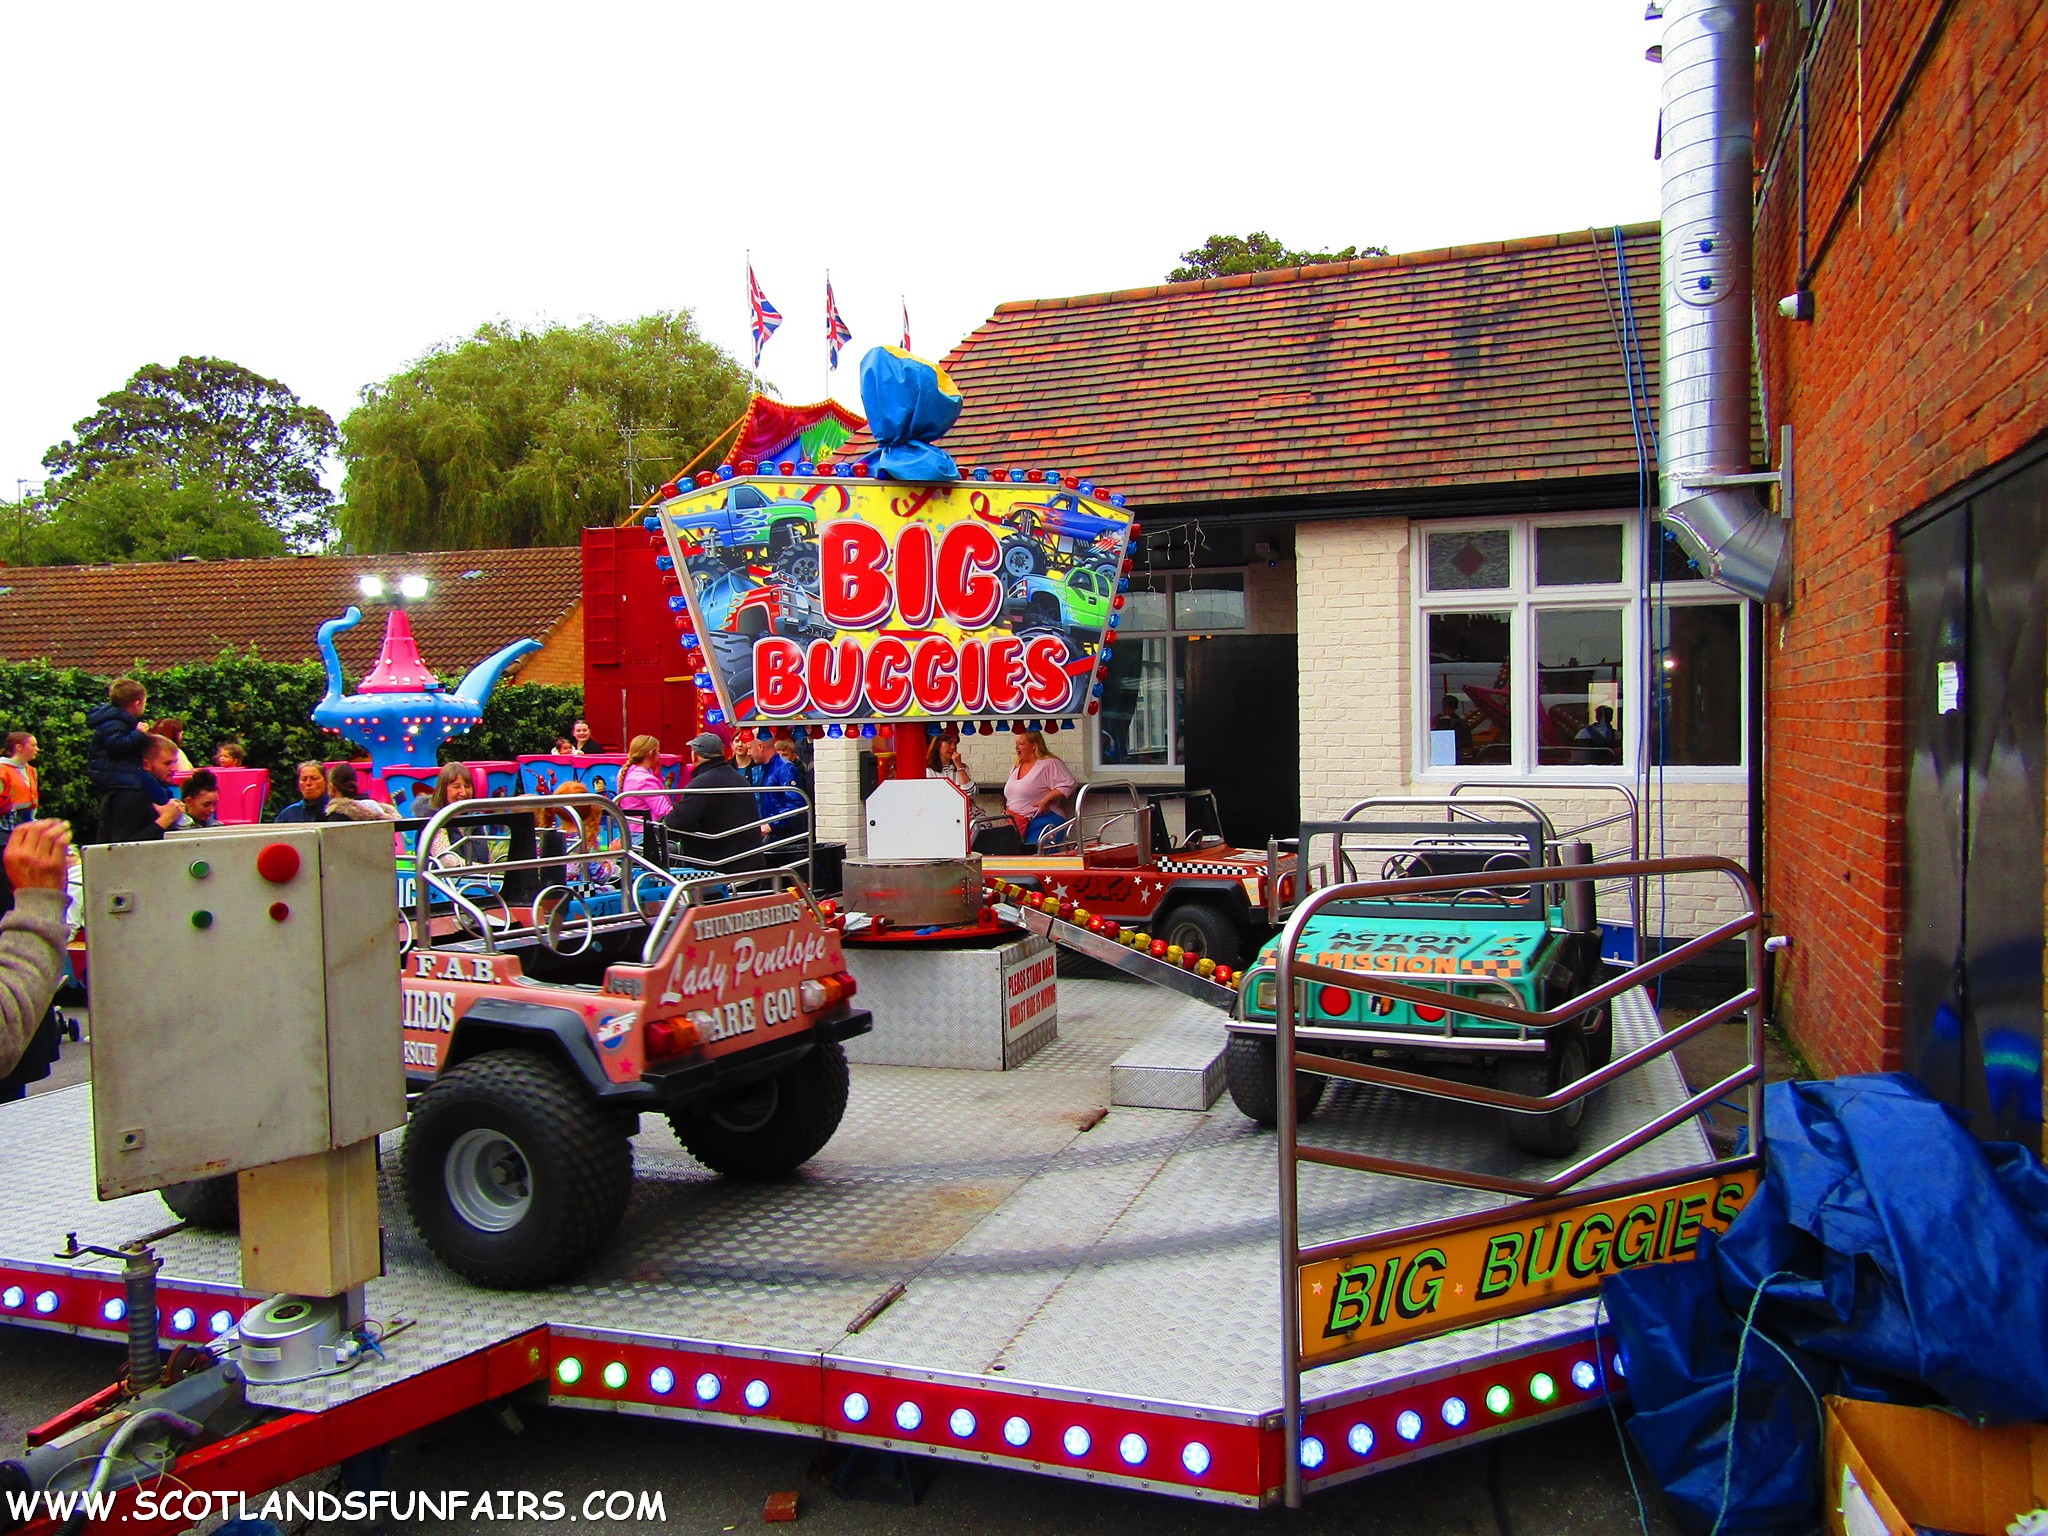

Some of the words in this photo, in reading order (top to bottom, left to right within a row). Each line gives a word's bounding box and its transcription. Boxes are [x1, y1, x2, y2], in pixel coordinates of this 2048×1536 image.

[818, 519, 1003, 630] BIG
[753, 634, 1073, 718] BUGGIES
[693, 902, 801, 941] THUNDERBIRDS
[1328, 932, 1472, 946] ACTION
[659, 950, 728, 1006] Lady
[733, 929, 826, 987] Penelope
[1316, 951, 1460, 976] MISSION
[1330, 941, 1458, 955] MAN
[415, 954, 502, 984] F.A.B.
[605, 970, 643, 1001] Jeep
[1008, 969, 1026, 999] PLEASE
[1026, 962, 1042, 989] STAND
[1042, 955, 1054, 980] BACK
[403, 989, 456, 1035] IRDS
[710, 997, 757, 1042] ARE
[763, 987, 798, 1027] GO!
[403, 1040, 438, 1067] ESCUE
[1323, 1247, 1447, 1339] BIG
[1475, 1183, 1744, 1301] BUGGIES
